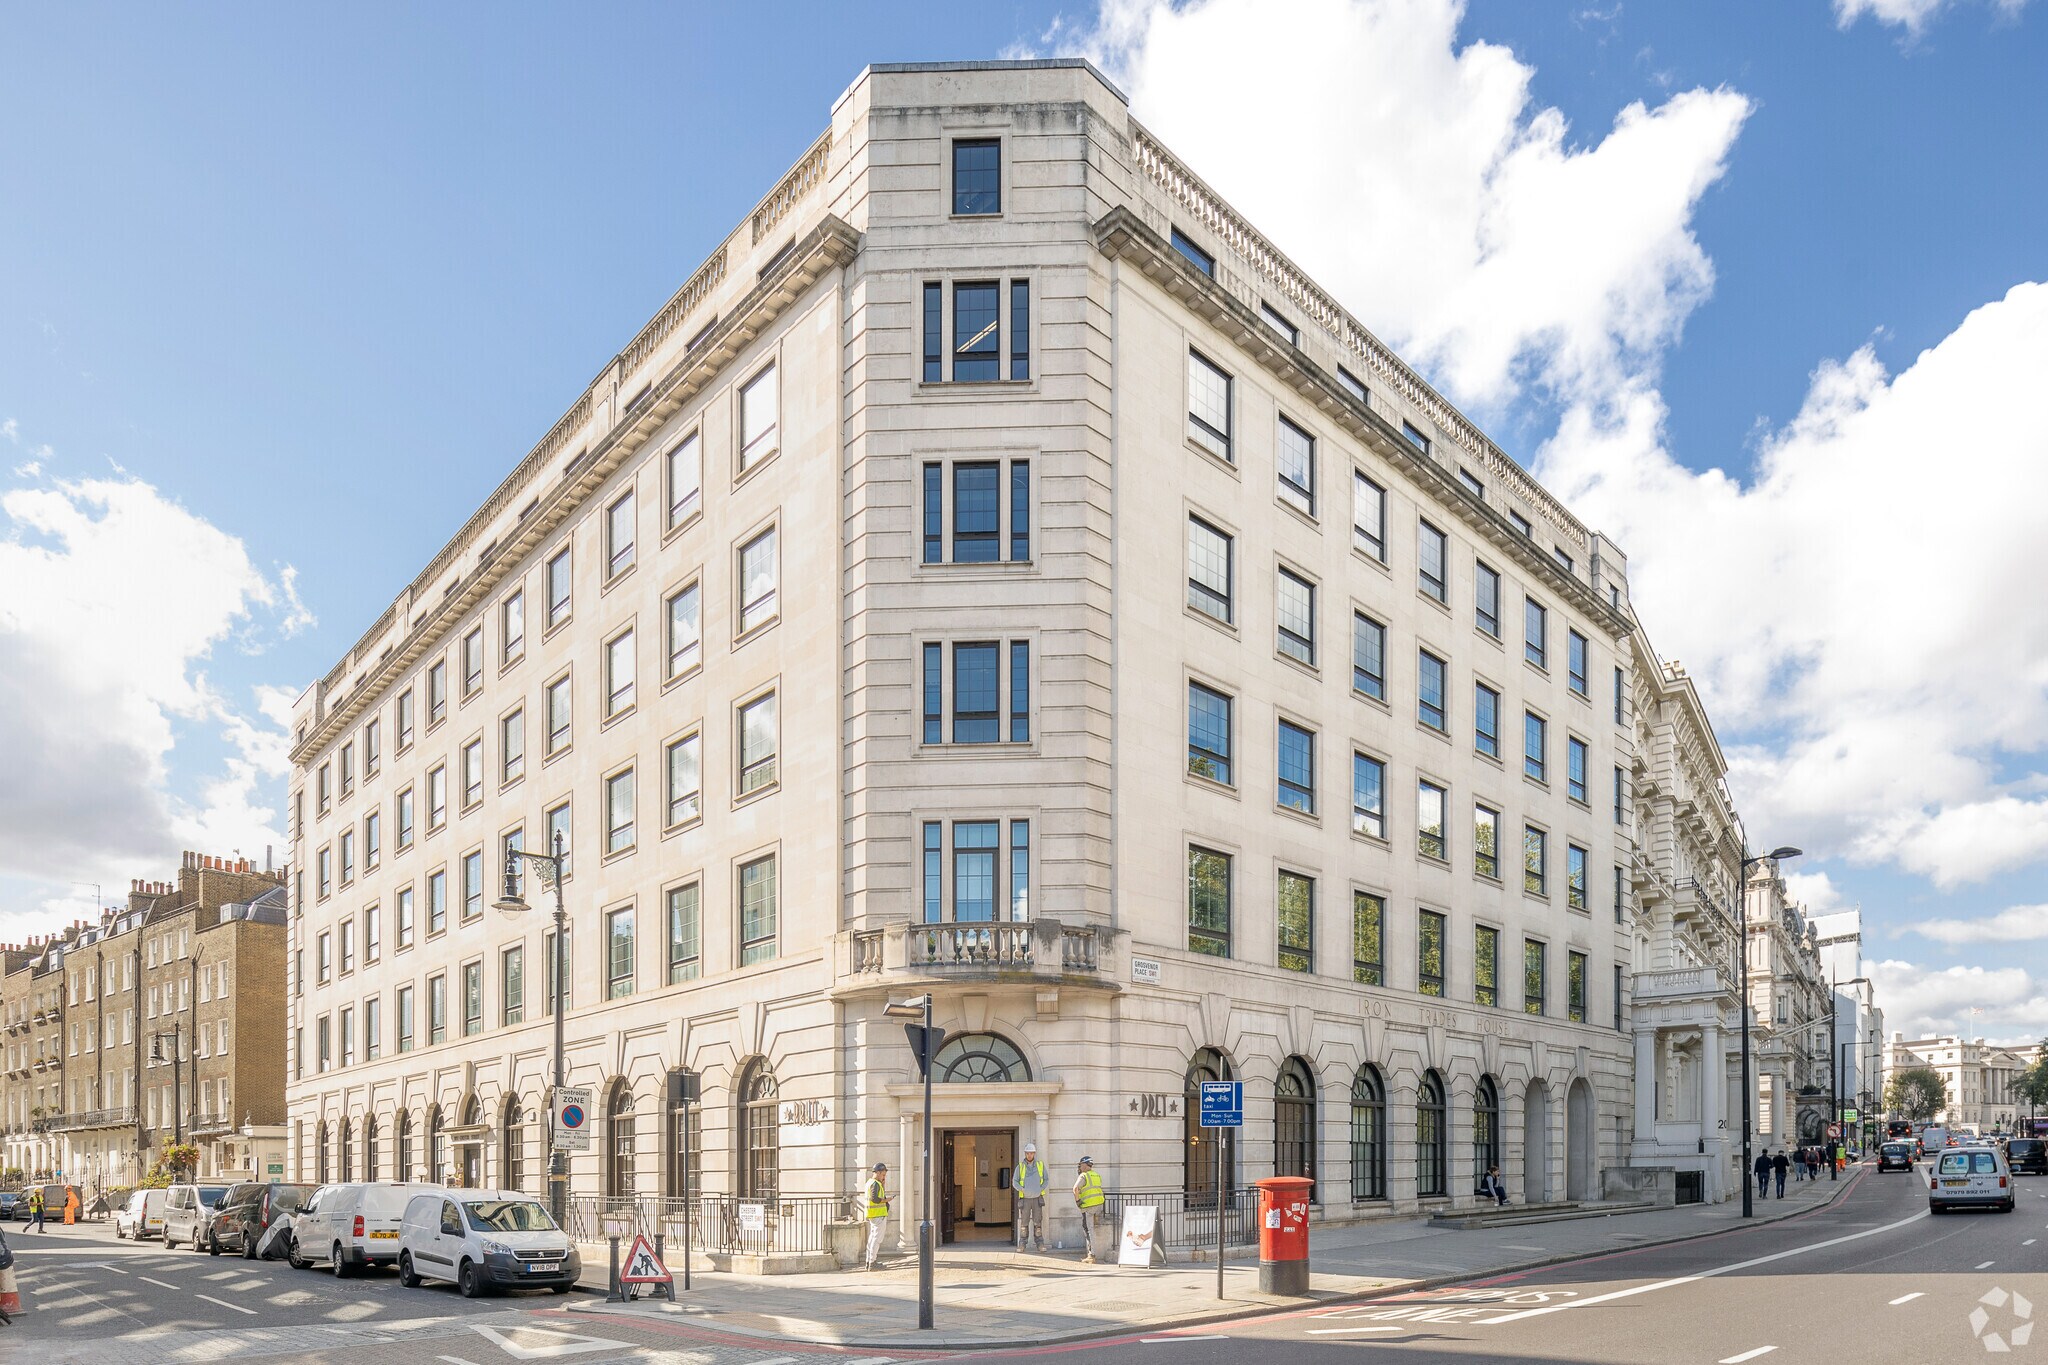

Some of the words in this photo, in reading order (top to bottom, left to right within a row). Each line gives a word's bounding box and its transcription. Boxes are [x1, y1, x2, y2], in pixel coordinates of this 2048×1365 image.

[1134, 960, 1158, 970] GROSVENOR
[1134, 968, 1147, 976] PLACE
[1358, 998, 1392, 1016] IRON
[1419, 1008, 1457, 1028] TRADES
[1476, 1018, 1509, 1036] HOUSE
[1141, 1093, 1167, 1118] PRET
[1306, 1305, 1520, 1324] LANE
